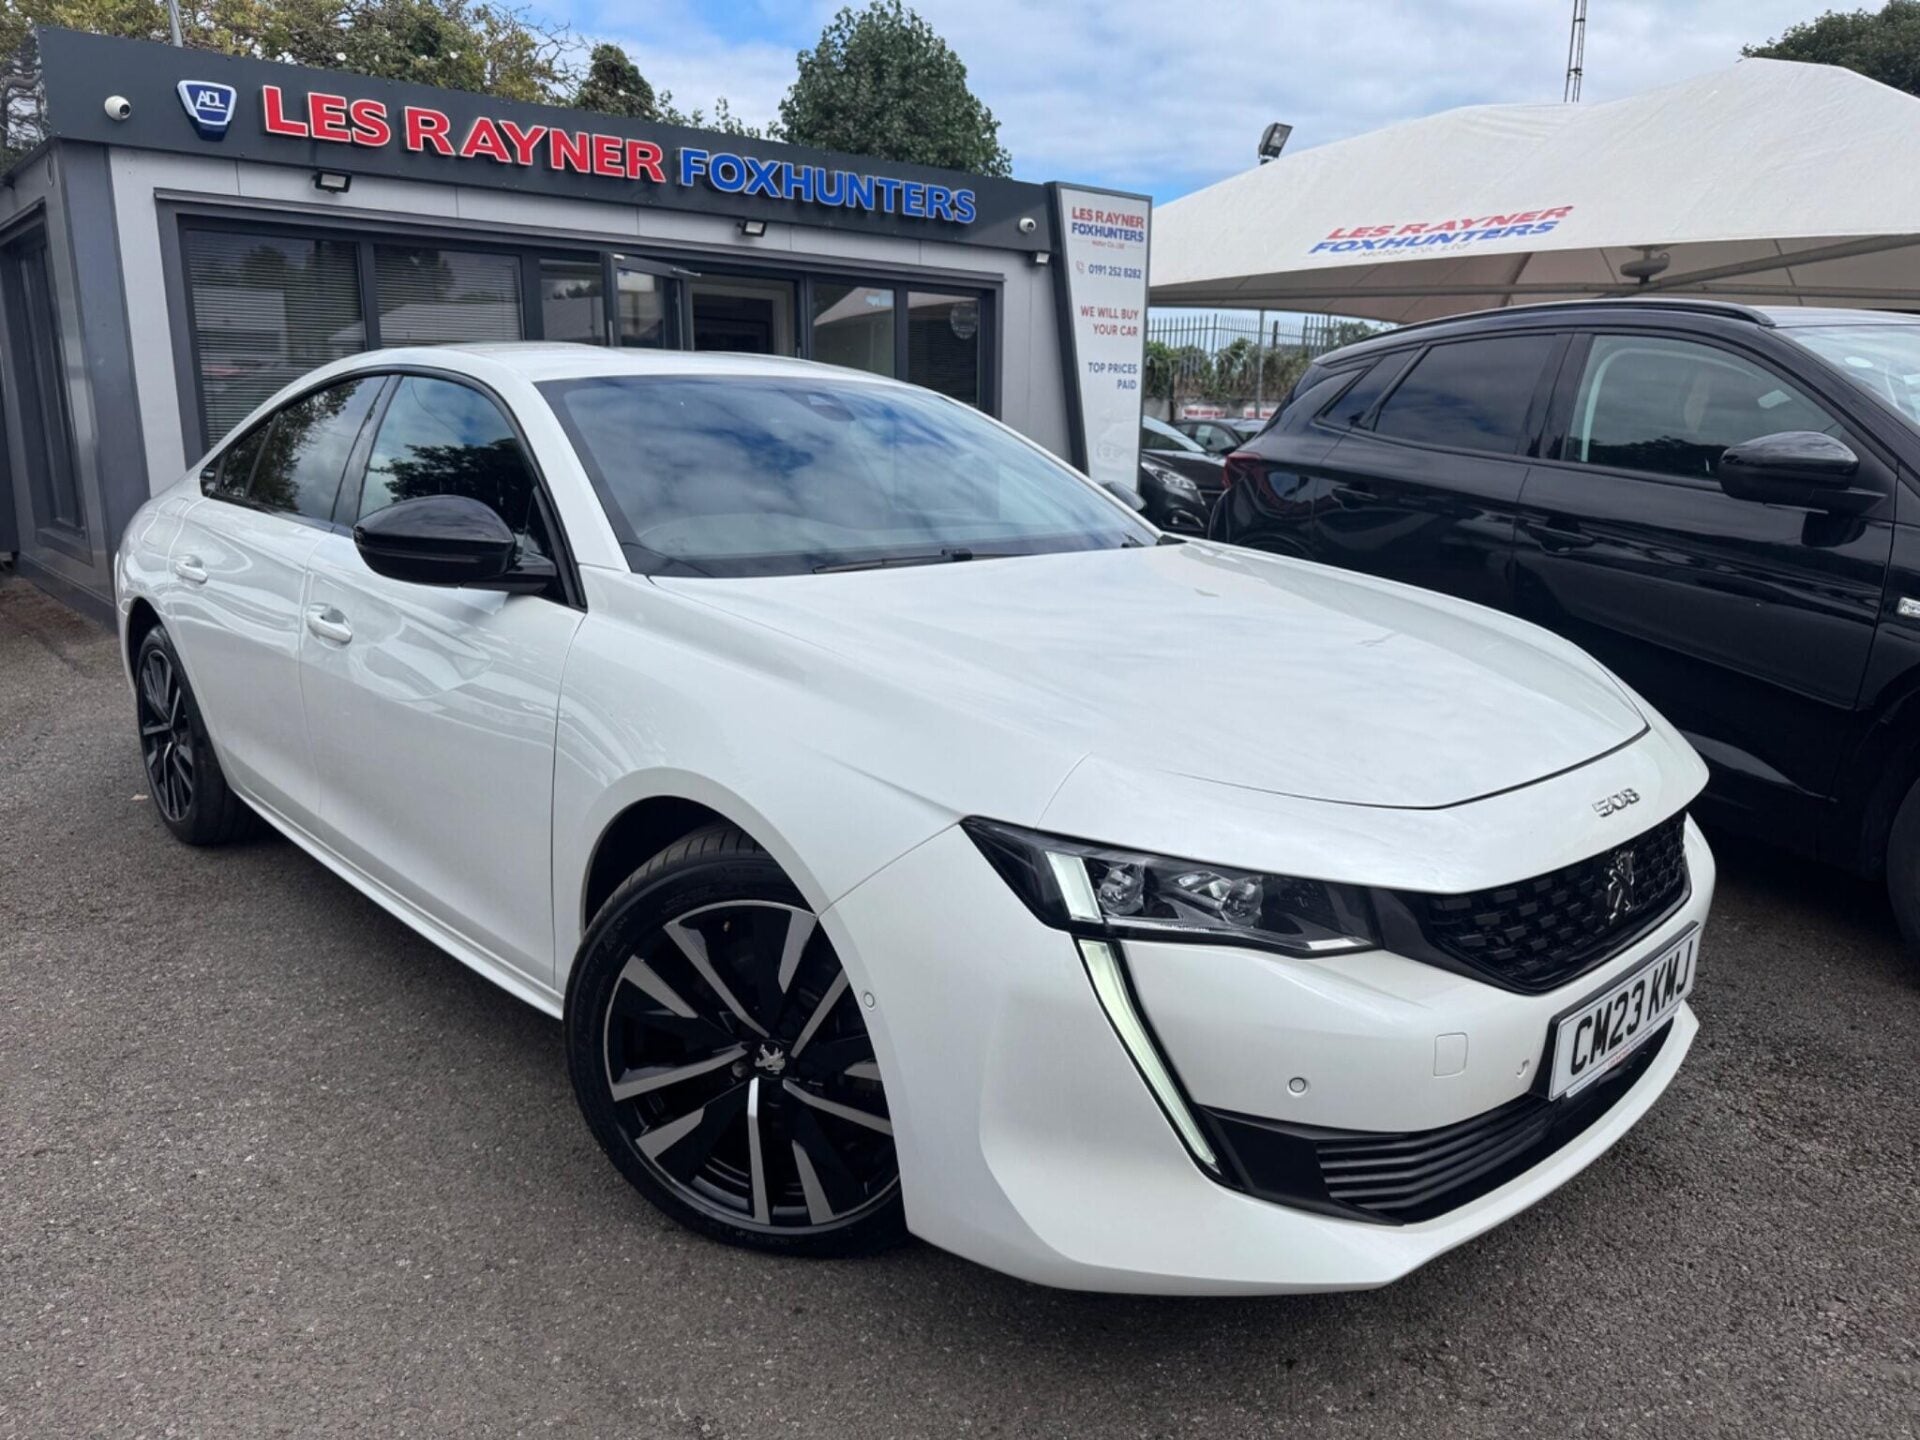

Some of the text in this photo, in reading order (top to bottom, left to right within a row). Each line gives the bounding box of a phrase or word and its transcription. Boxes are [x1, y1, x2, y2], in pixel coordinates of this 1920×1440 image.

[195, 89, 226, 109] ADL
[263, 85, 978, 225] LES RAYNER FOXHUNTERS
[1072, 207, 1144, 229] LES RAYNER
[1326, 205, 1575, 240] LES RAYNER
[1072, 222, 1144, 242] FOXHUNTERS
[1308, 220, 1560, 255] FOXHUNTERS
[1088, 264, 1142, 279] 0191 252 8282
[1081, 305, 1139, 320] WE WILL BUY
[1093, 324, 1138, 337] YOUR CAR
[1088, 362, 1138, 375] TOP PRICES
[1117, 379, 1137, 390] PAID
[1592, 788, 1640, 817] 508
